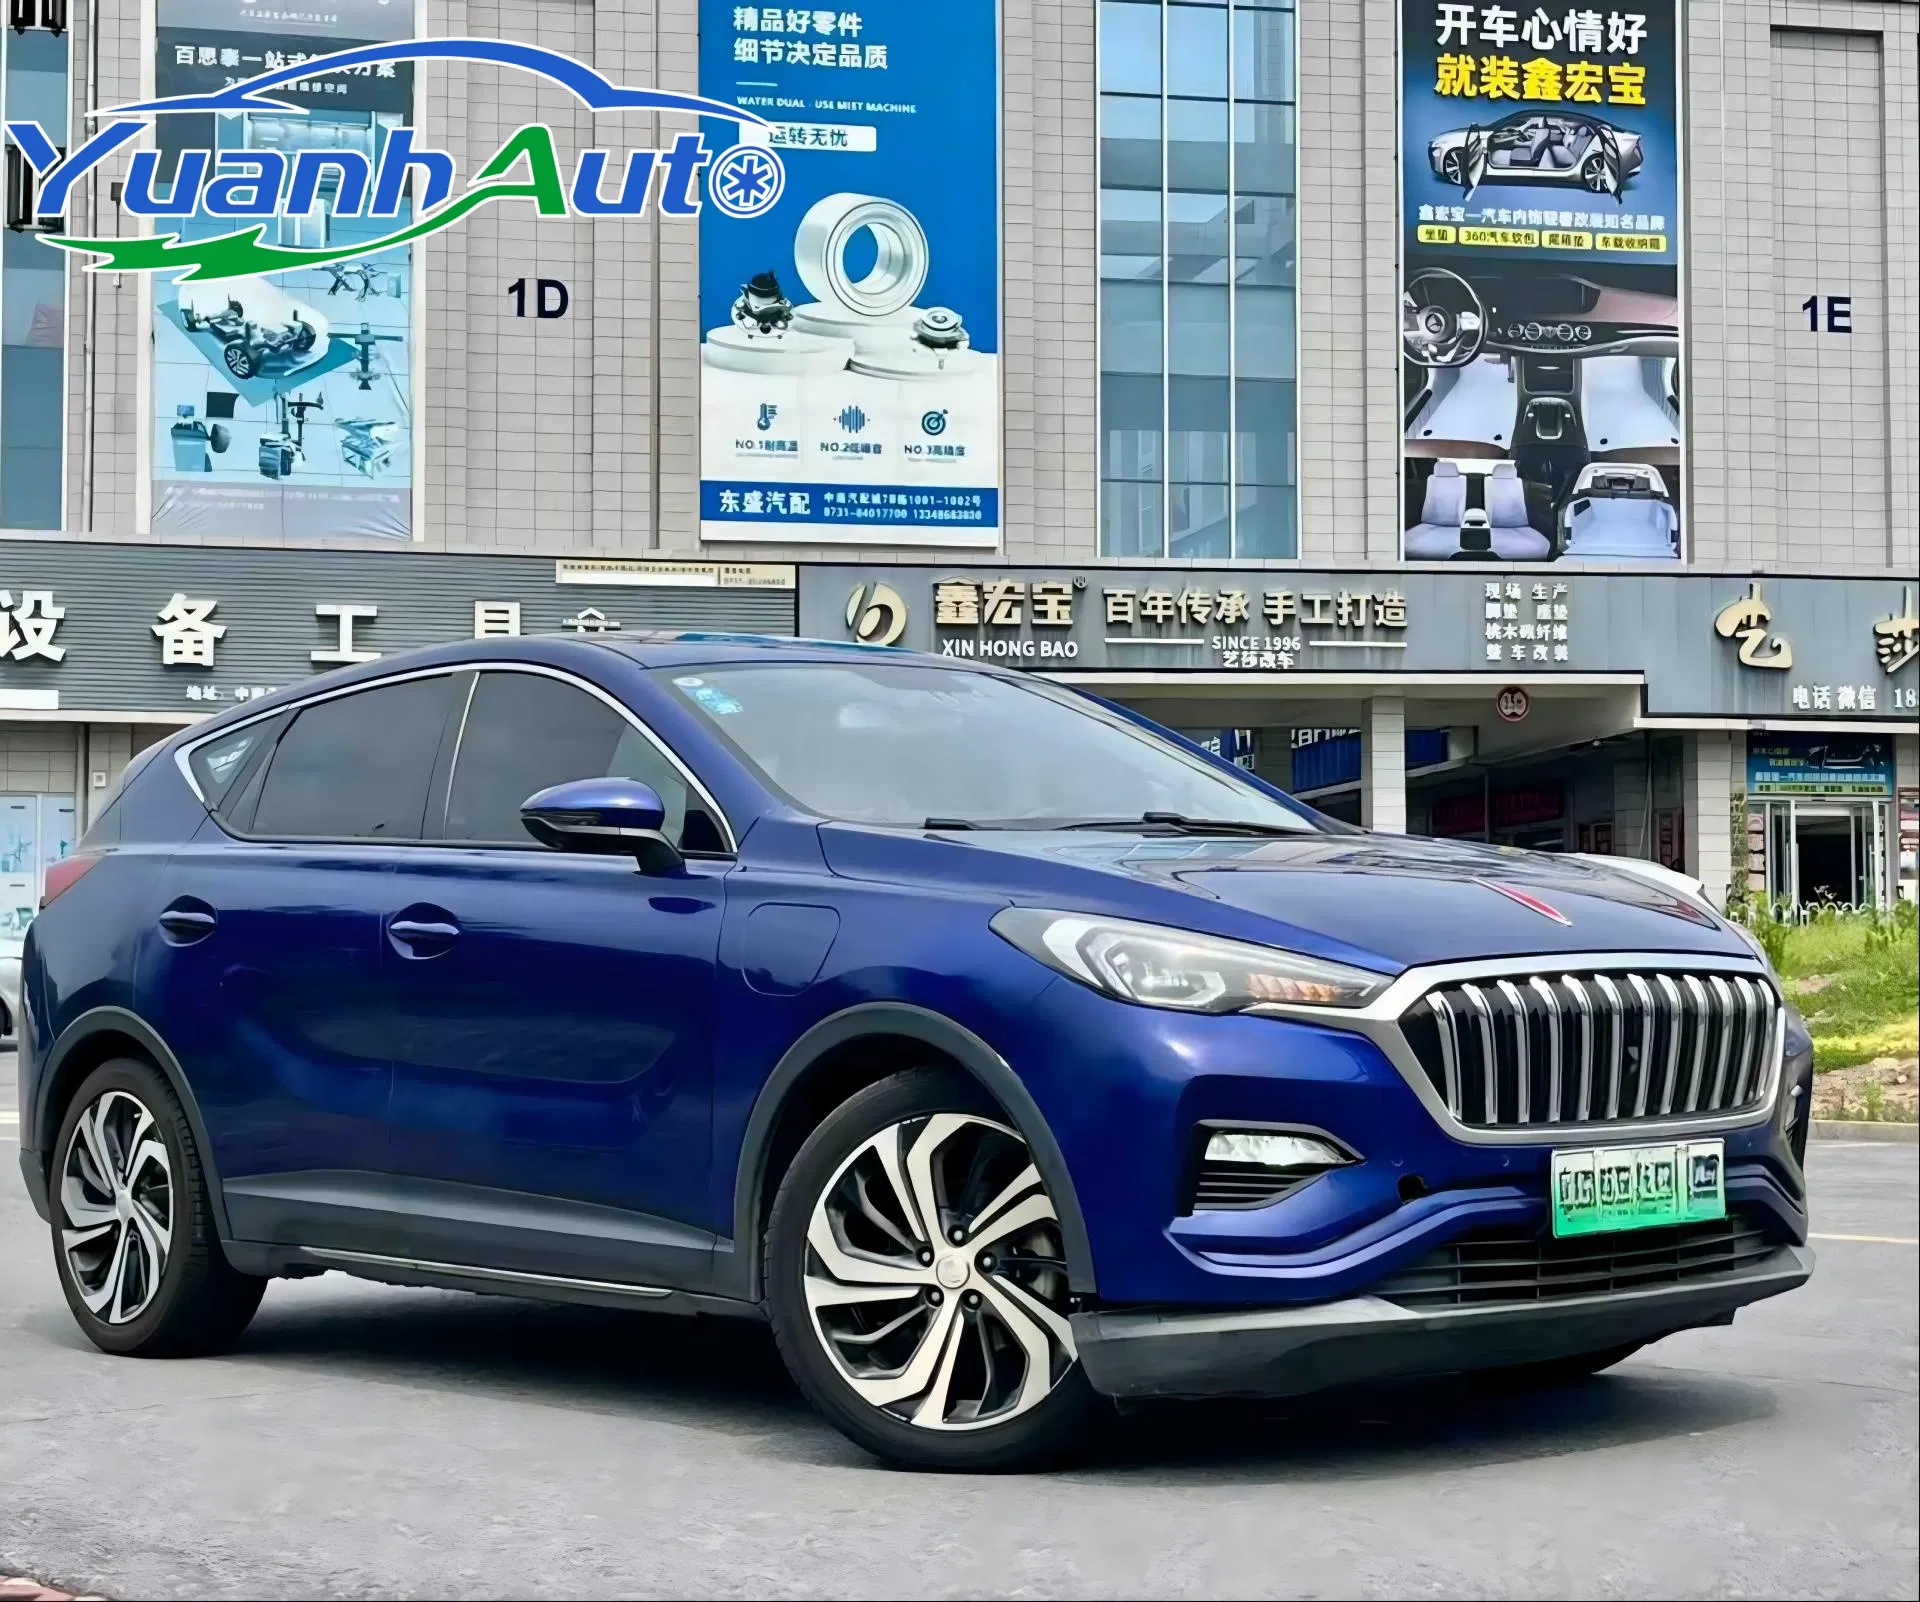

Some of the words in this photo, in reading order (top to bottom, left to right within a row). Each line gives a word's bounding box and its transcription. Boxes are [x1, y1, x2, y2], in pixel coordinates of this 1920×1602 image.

[733, 6, 863, 37] 精品好零件
[1435, 3, 1647, 54] 开车心情好
[733, 38, 888, 69] 细节决定品质
[1434, 53, 1646, 105] 就装鑫宏宝
[737, 96, 774, 107] WATER
[776, 98, 805, 108] DUAL
[866, 102, 917, 113] MACHINE
[769, 126, 848, 147] 运转无忧
[506, 278, 570, 320] 1D
[1802, 295, 1852, 333] 1E
[719, 488, 811, 515] 东盛汽配
[934, 578, 1074, 625] 鑫宏宝
[1485, 582, 1521, 600] 现场
[1532, 583, 1568, 600] 生产
[1103, 588, 1250, 625] 百年传承
[1263, 588, 1408, 627] 手工打造
[942, 639, 974, 657] XIN
[980, 640, 1034, 657] HONG
[1041, 641, 1078, 658] BAO
[1212, 636, 1260, 649] SINCE
[1264, 637, 1300, 650] 1996
[1223, 651, 1293, 668] 艺莎改车
[1793, 685, 1831, 710] 电话
[1837, 685, 1876, 710] 微信
